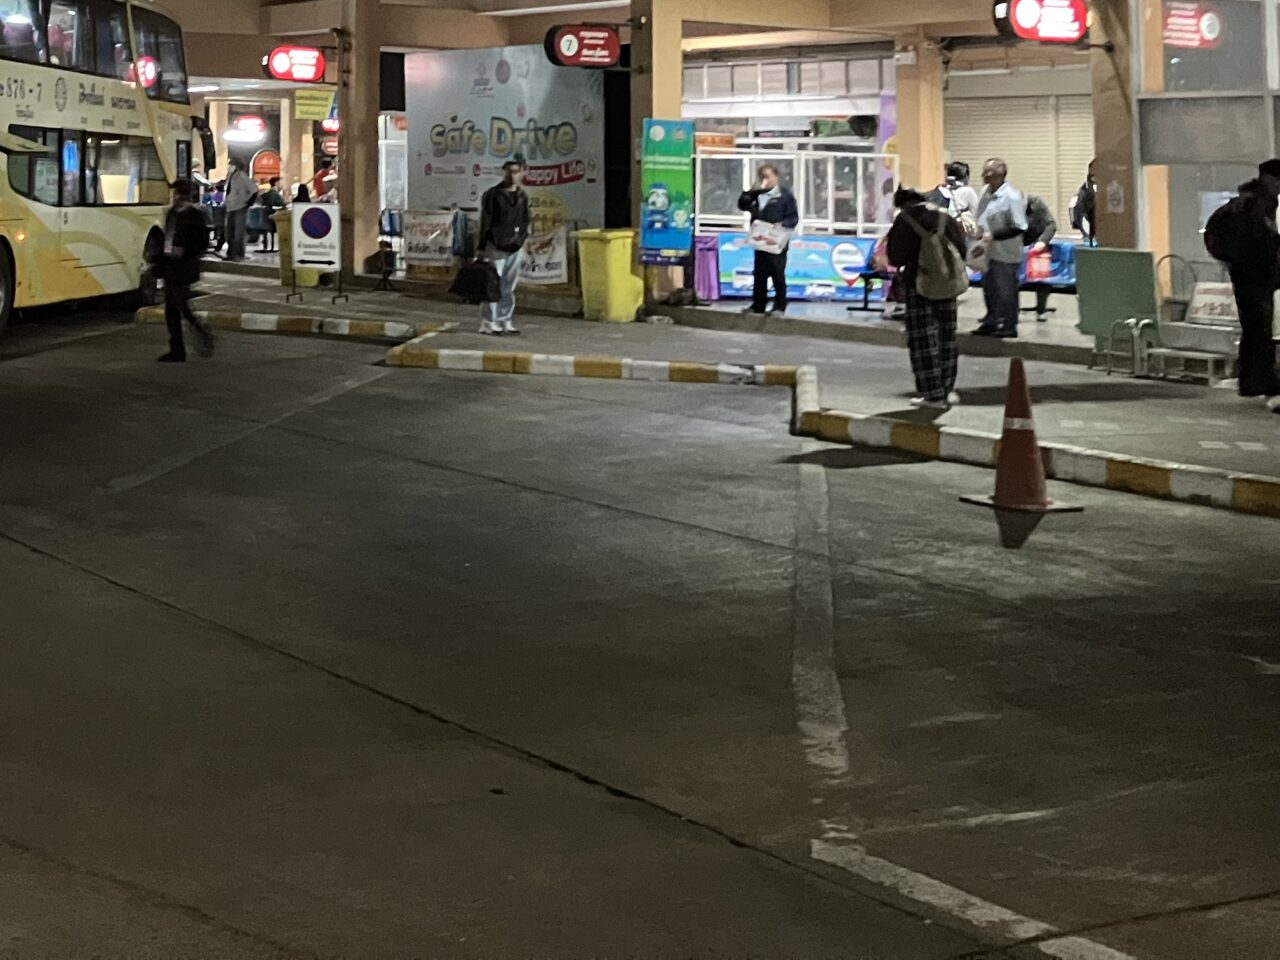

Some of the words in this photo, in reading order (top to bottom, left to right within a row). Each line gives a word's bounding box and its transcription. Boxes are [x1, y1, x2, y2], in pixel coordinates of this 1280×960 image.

[430, 120, 486, 157] Safe
[489, 116, 578, 160] Drive
[561, 160, 584, 178] Life
